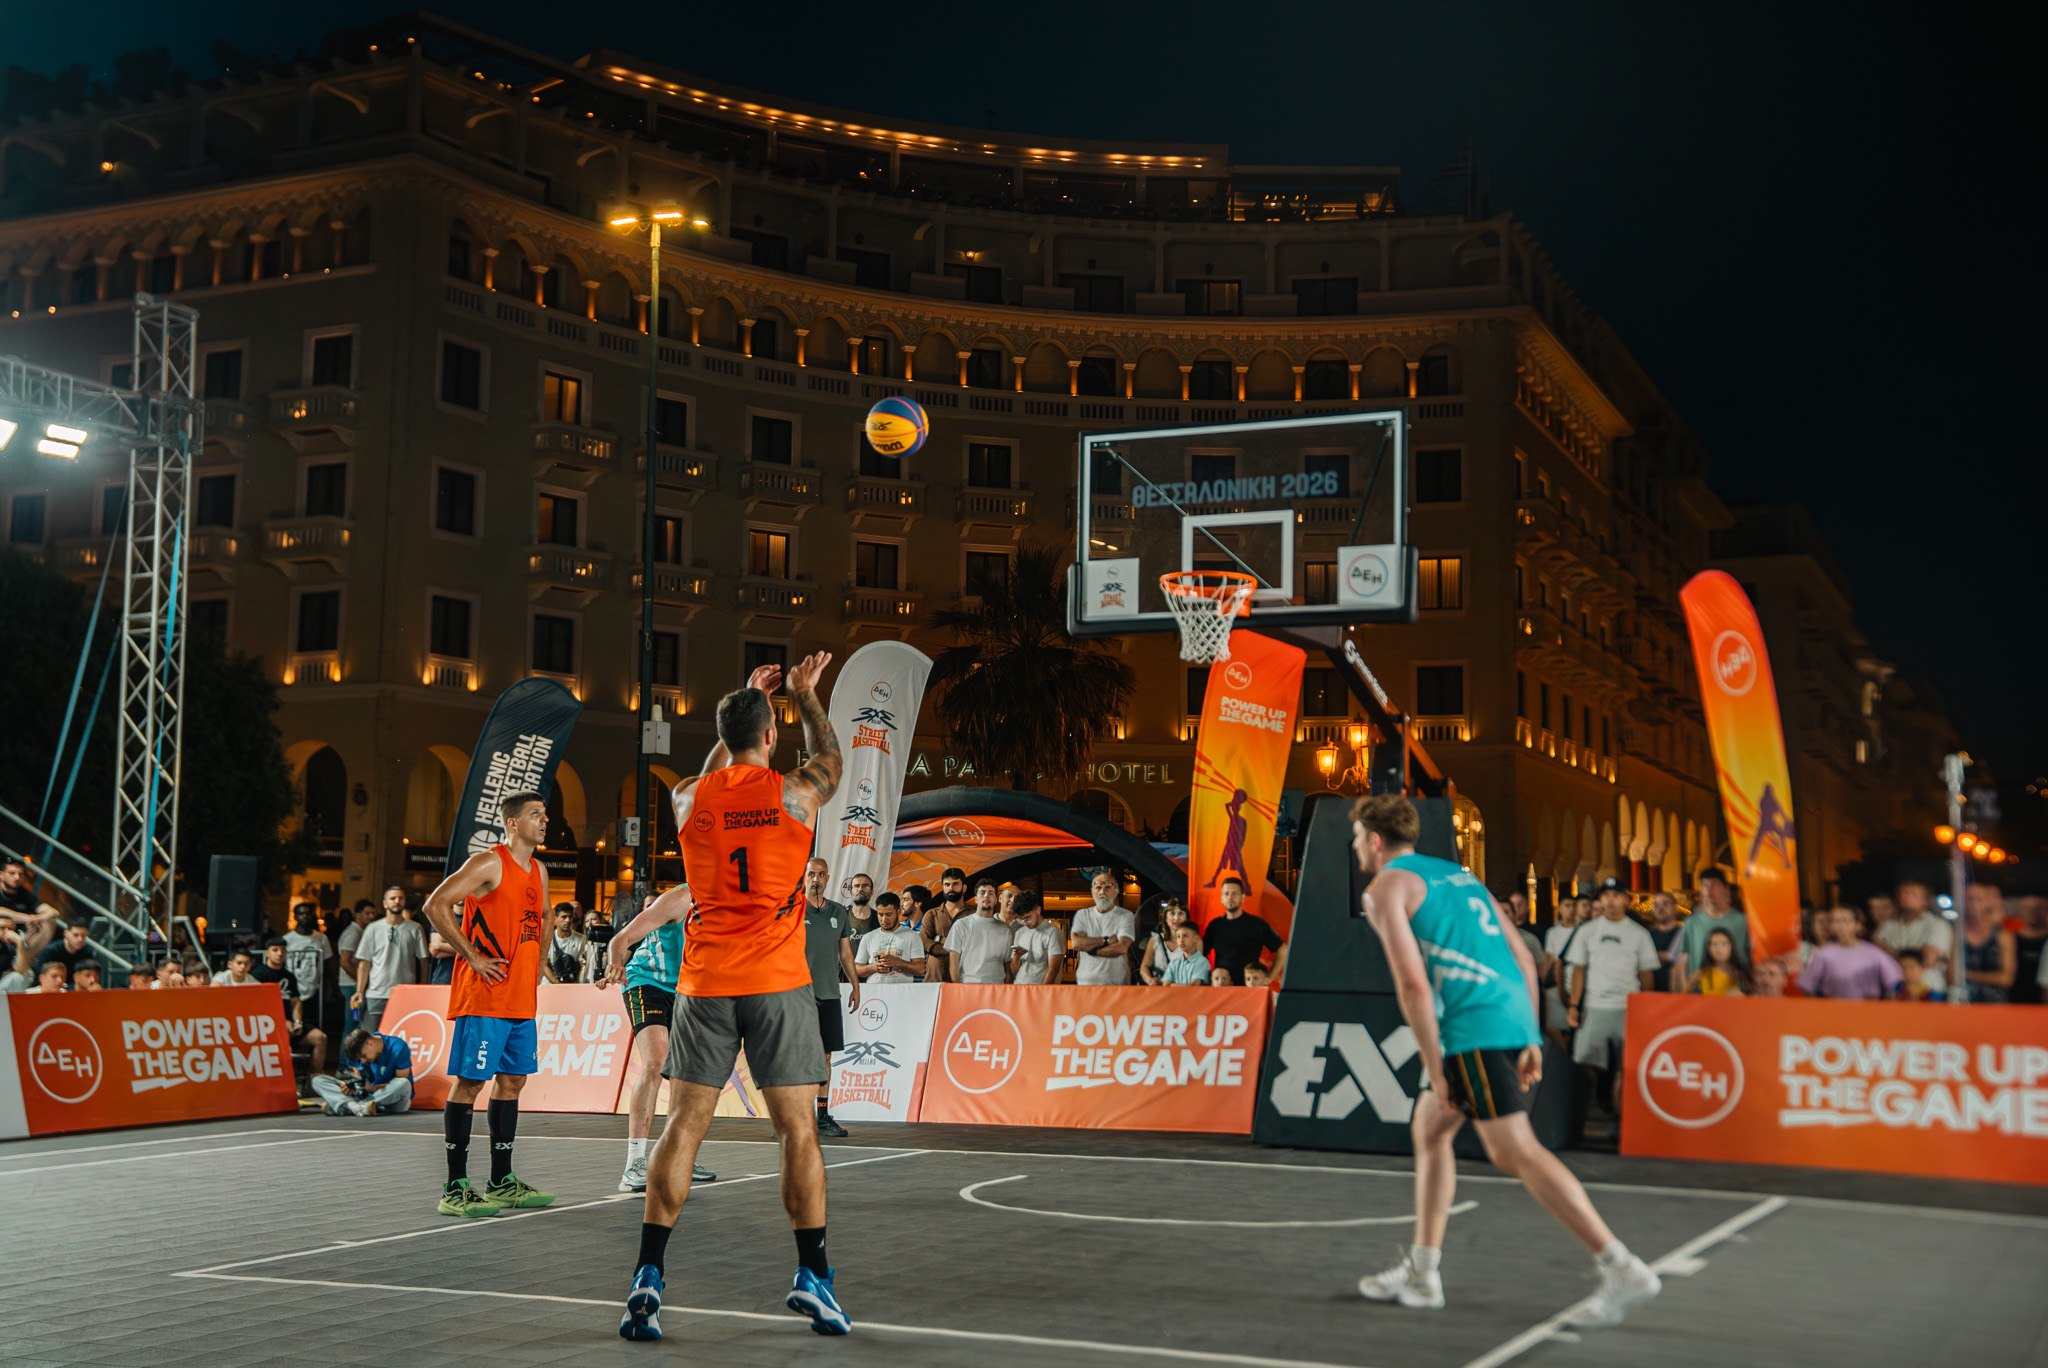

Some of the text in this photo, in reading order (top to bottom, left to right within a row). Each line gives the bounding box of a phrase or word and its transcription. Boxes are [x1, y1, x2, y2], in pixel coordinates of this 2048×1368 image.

[1281, 470, 1339, 498] 2026
[1220, 696, 1287, 720] POWER UP
[1220, 706, 1286, 733] THE GAME
[851, 735, 891, 755] BASKETBALL
[858, 724, 889, 741] STREET
[474, 751, 511, 825] HELLENIC
[724, 808, 779, 820] POWER UP
[724, 817, 779, 828] THE GAME
[841, 835, 876, 852] BASKETBALL
[847, 823, 873, 837] STREET
[729, 846, 749, 892] 1
[1468, 897, 1500, 935] 2
[581, 1014, 622, 1041] UP
[862, 1007, 883, 1022] ΔΕΗ
[121, 1015, 276, 1050] POWER UP
[1052, 1014, 1249, 1047] POWER UP
[37, 1042, 93, 1078] ΔΕΗ
[127, 1044, 283, 1083] THE GAME
[476, 1049, 488, 1070] 5
[533, 1043, 617, 1077] AME
[952, 1031, 1010, 1070] ΔΕΗ
[1779, 1034, 2048, 1085] POWER UP
[840, 1069, 888, 1087] STREET
[1051, 1048, 1246, 1087] THE GAME
[1650, 1051, 1728, 1100] ΔΕΗ
[829, 1088, 891, 1110] BASKETBALL
[1779, 1074, 2048, 1136] THE GAME
